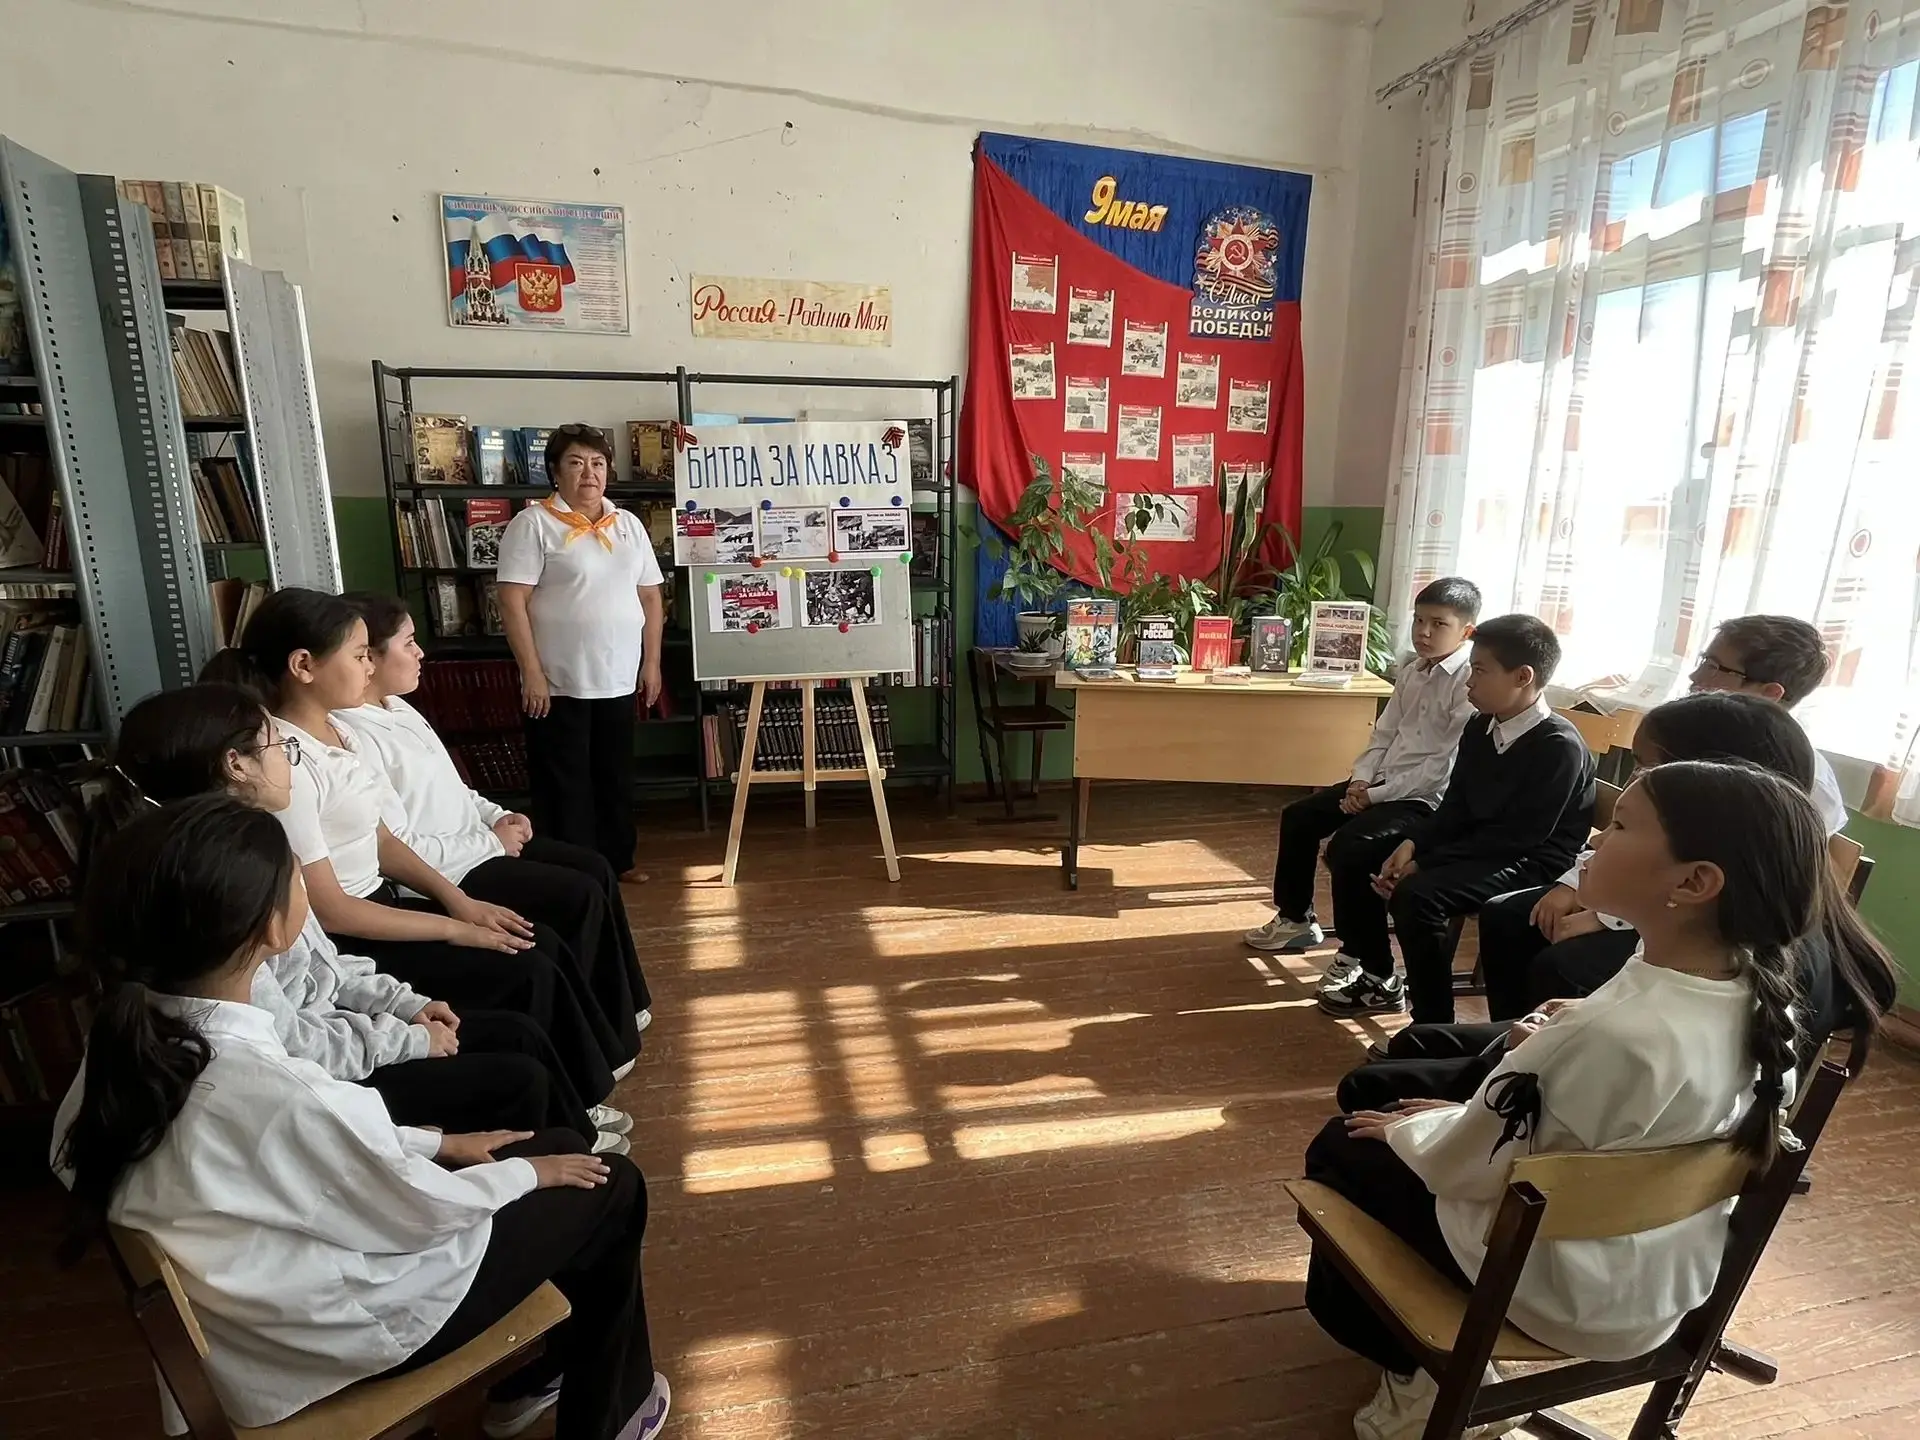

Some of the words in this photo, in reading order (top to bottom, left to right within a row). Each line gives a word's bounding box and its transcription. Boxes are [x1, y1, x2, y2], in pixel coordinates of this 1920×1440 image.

[854, 301, 889, 331] Моя
[1190, 319, 1273, 338] ПОБЕДЫ!
[687, 445, 763, 489] БИТВА
[768, 444, 800, 486] ЗА
[804, 443, 898, 485] КАВКАЗ
